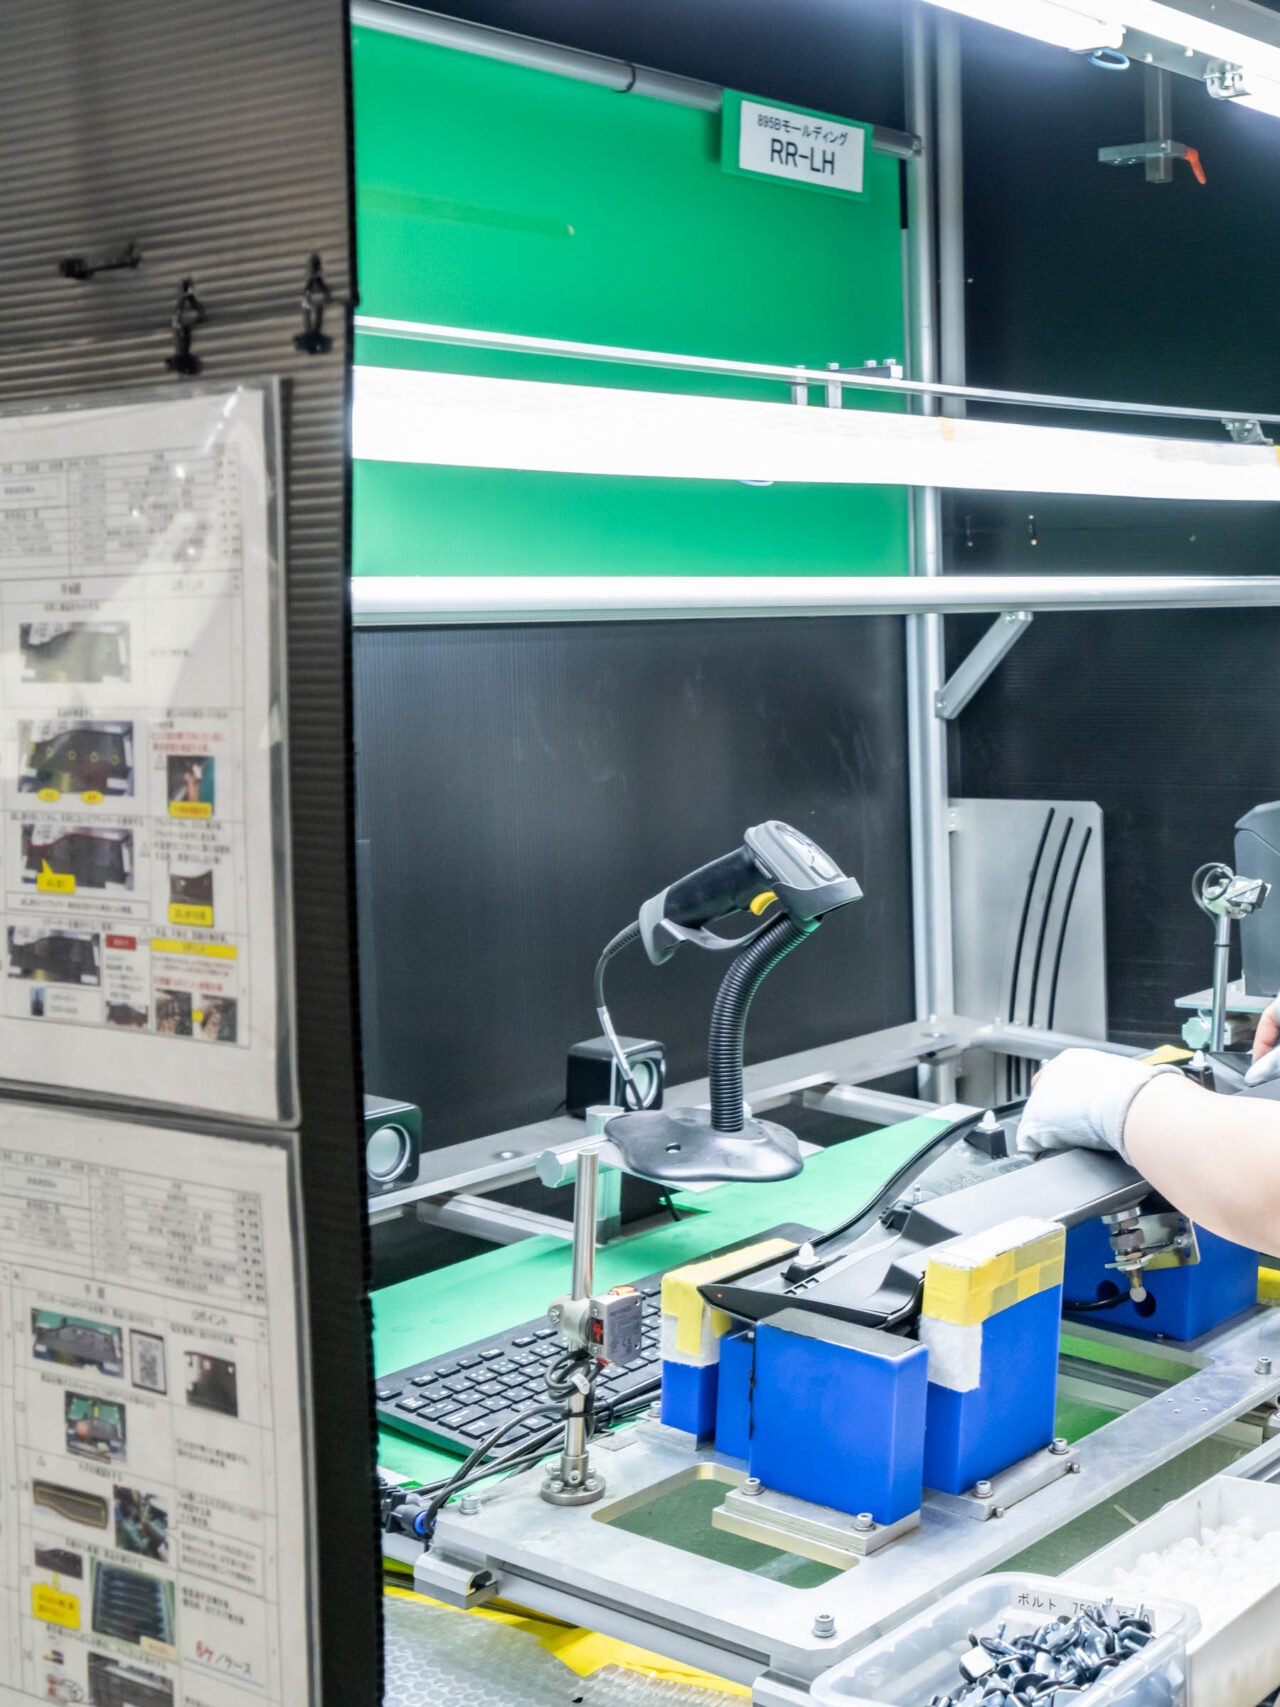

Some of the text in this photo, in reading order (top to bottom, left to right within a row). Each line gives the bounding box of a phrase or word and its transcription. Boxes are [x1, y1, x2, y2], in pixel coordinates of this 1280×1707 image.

[757, 114, 848, 146] 895Bモールディング
[770, 138, 836, 175] RR-LH
[1018, 1593, 1056, 1611] ボルト
